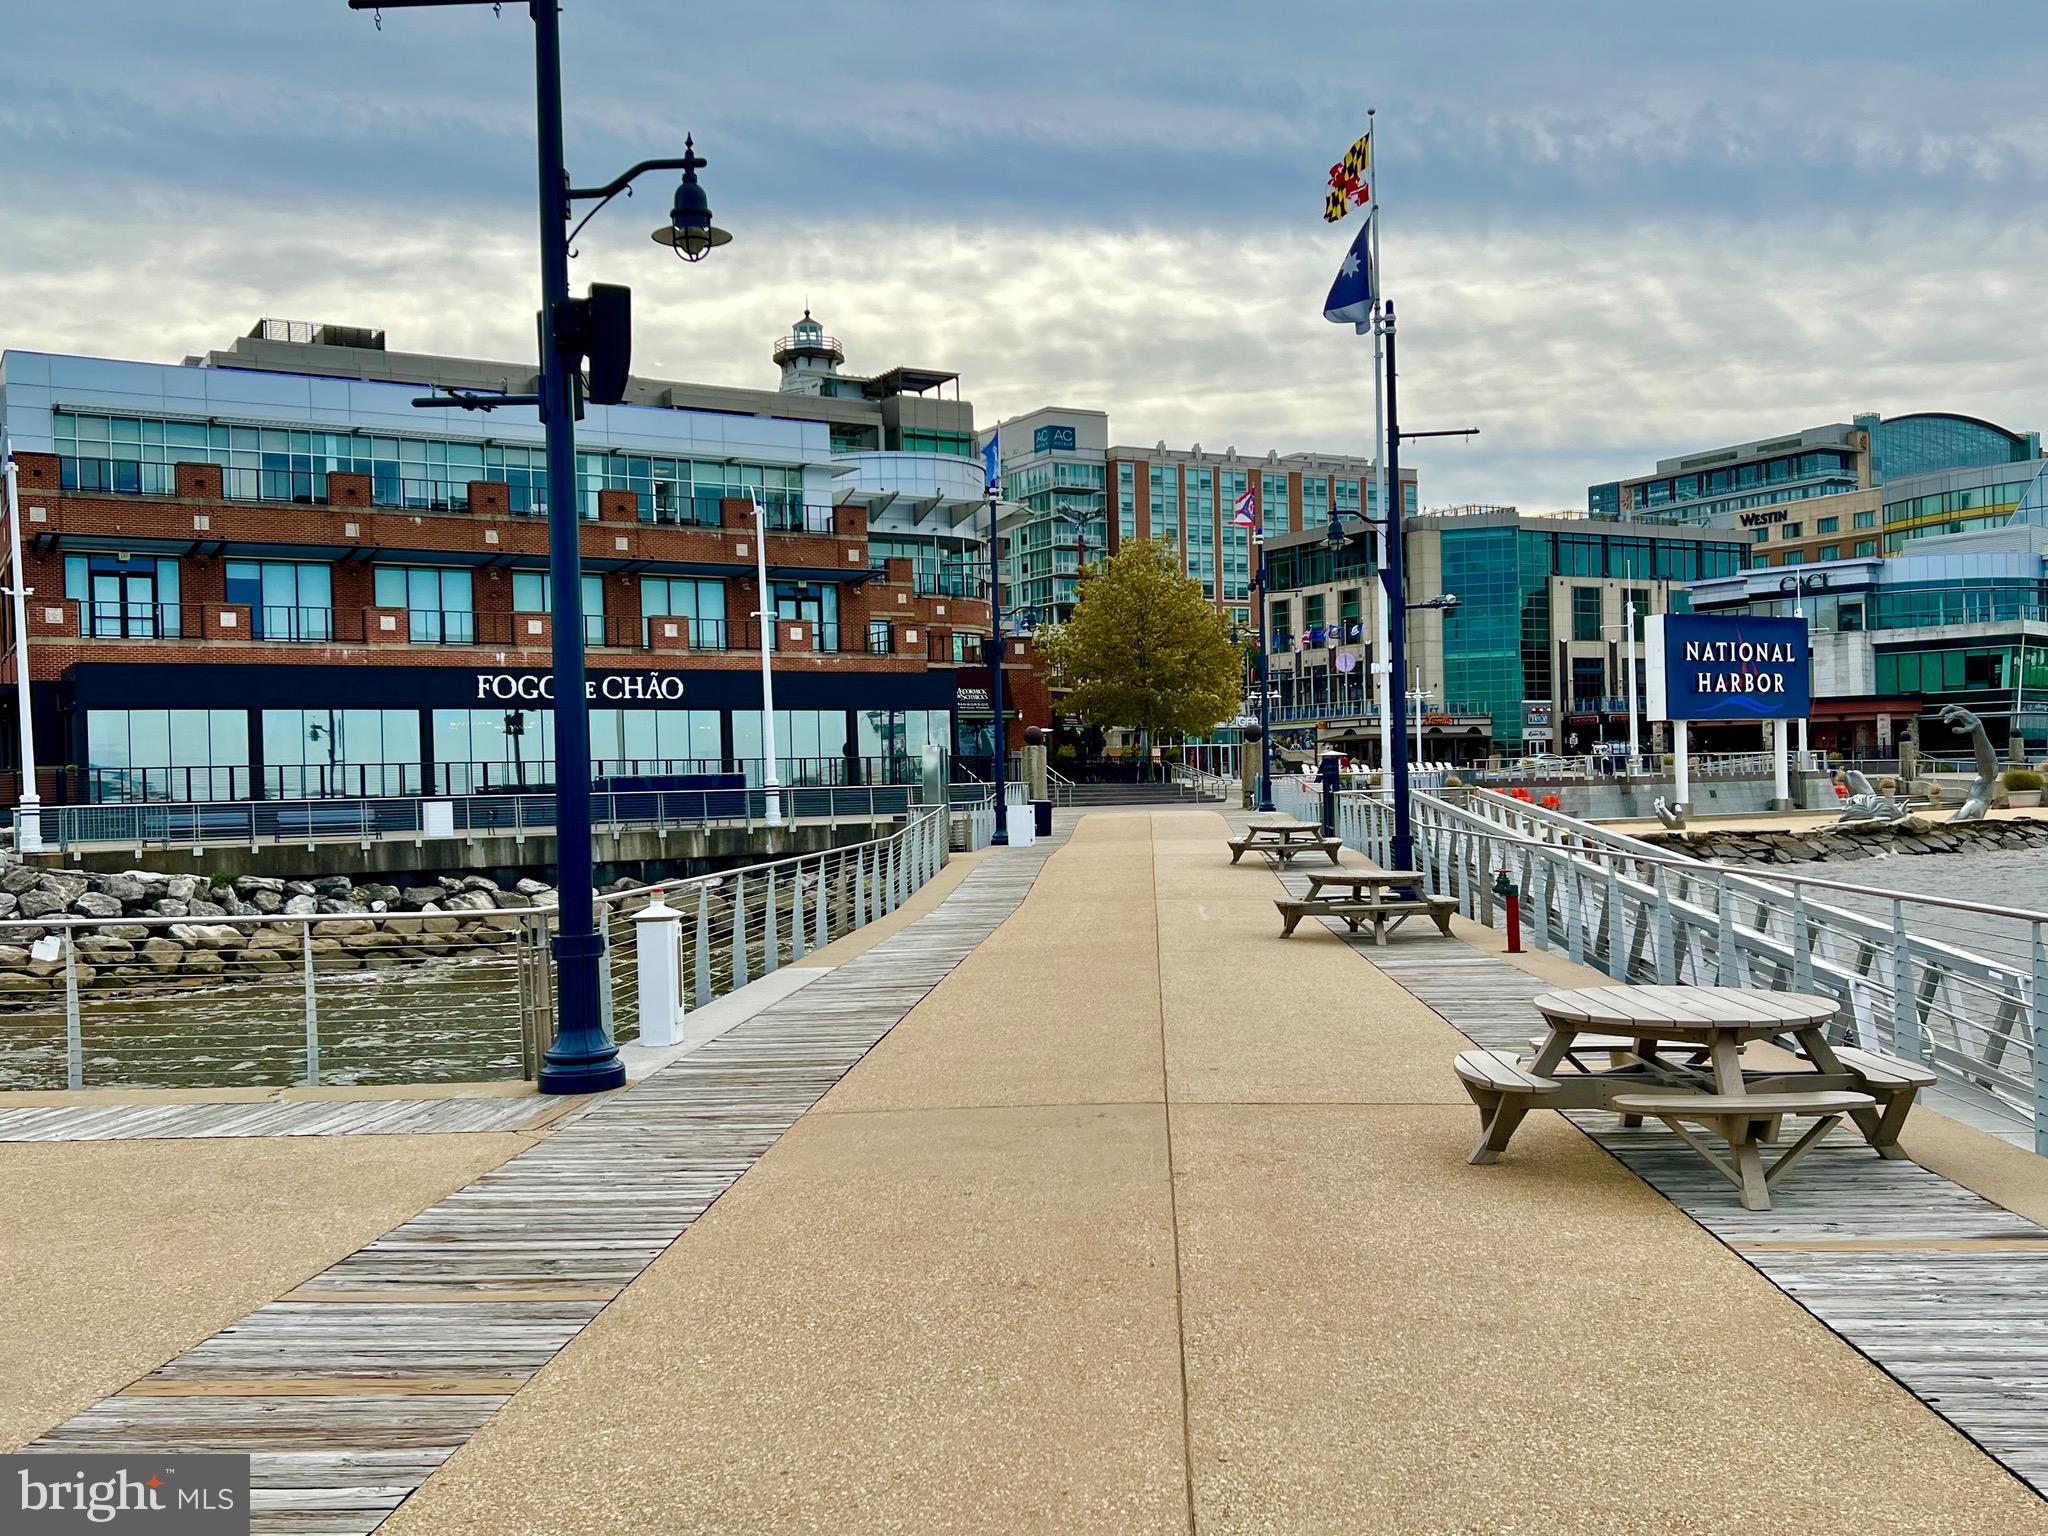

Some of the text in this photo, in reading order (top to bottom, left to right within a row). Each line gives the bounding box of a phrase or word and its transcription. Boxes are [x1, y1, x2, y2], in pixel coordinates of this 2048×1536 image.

[1054, 430, 1073, 442] AC
[1686, 641, 1796, 662] NATIONAL
[602, 672, 684, 699] CHÃO
[1697, 672, 1785, 693] HARBOR
